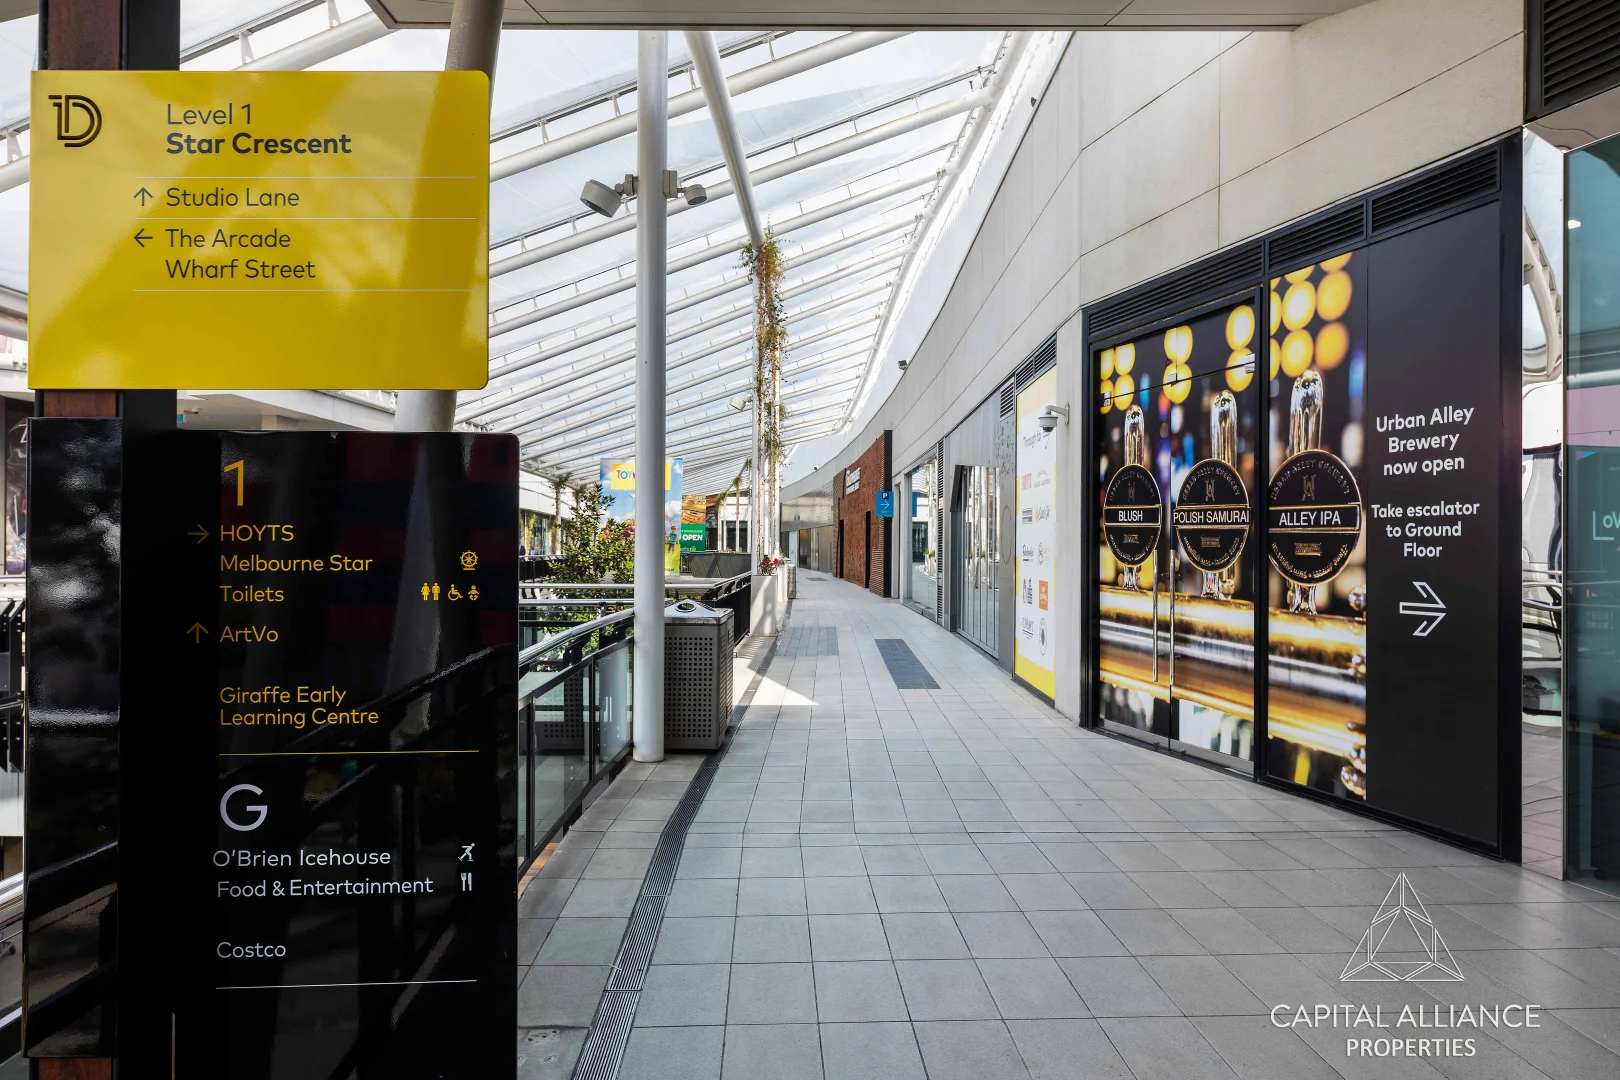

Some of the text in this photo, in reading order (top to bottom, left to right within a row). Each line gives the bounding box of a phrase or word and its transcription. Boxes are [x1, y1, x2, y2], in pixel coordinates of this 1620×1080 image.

[167, 103, 251, 125] Level 1
[166, 132, 353, 155] Star Crescent
[166, 187, 300, 207] Studio Lane
[165, 227, 291, 248] The Arcade
[165, 259, 316, 279] Wharf Street
[1376, 405, 1475, 433] Urban Alley
[1388, 433, 1460, 454] Brewery
[1383, 456, 1465, 476] now open
[223, 460, 244, 506] 1
[1118, 510, 1143, 522] BLUSH
[1173, 510, 1250, 524] POLISH SAMURAI
[1278, 510, 1341, 526] ALLEY IPA
[1371, 501, 1481, 519] Take escalator
[220, 524, 294, 542] HOYTS
[682, 533, 703, 541] OPEN
[1385, 521, 1462, 538] to Ground
[1403, 542, 1443, 558] Floor
[220, 554, 373, 572] Melbourne Star
[220, 585, 285, 602] Toilets
[220, 625, 279, 642] ArtVo
[220, 686, 347, 707] Giraffe Early
[220, 708, 379, 729] Learning Centre
[220, 784, 268, 832] G
[212, 849, 391, 868] O'Brien Icehouse
[217, 877, 434, 898] Food & Entertainment
[216, 942, 287, 959] Costco
